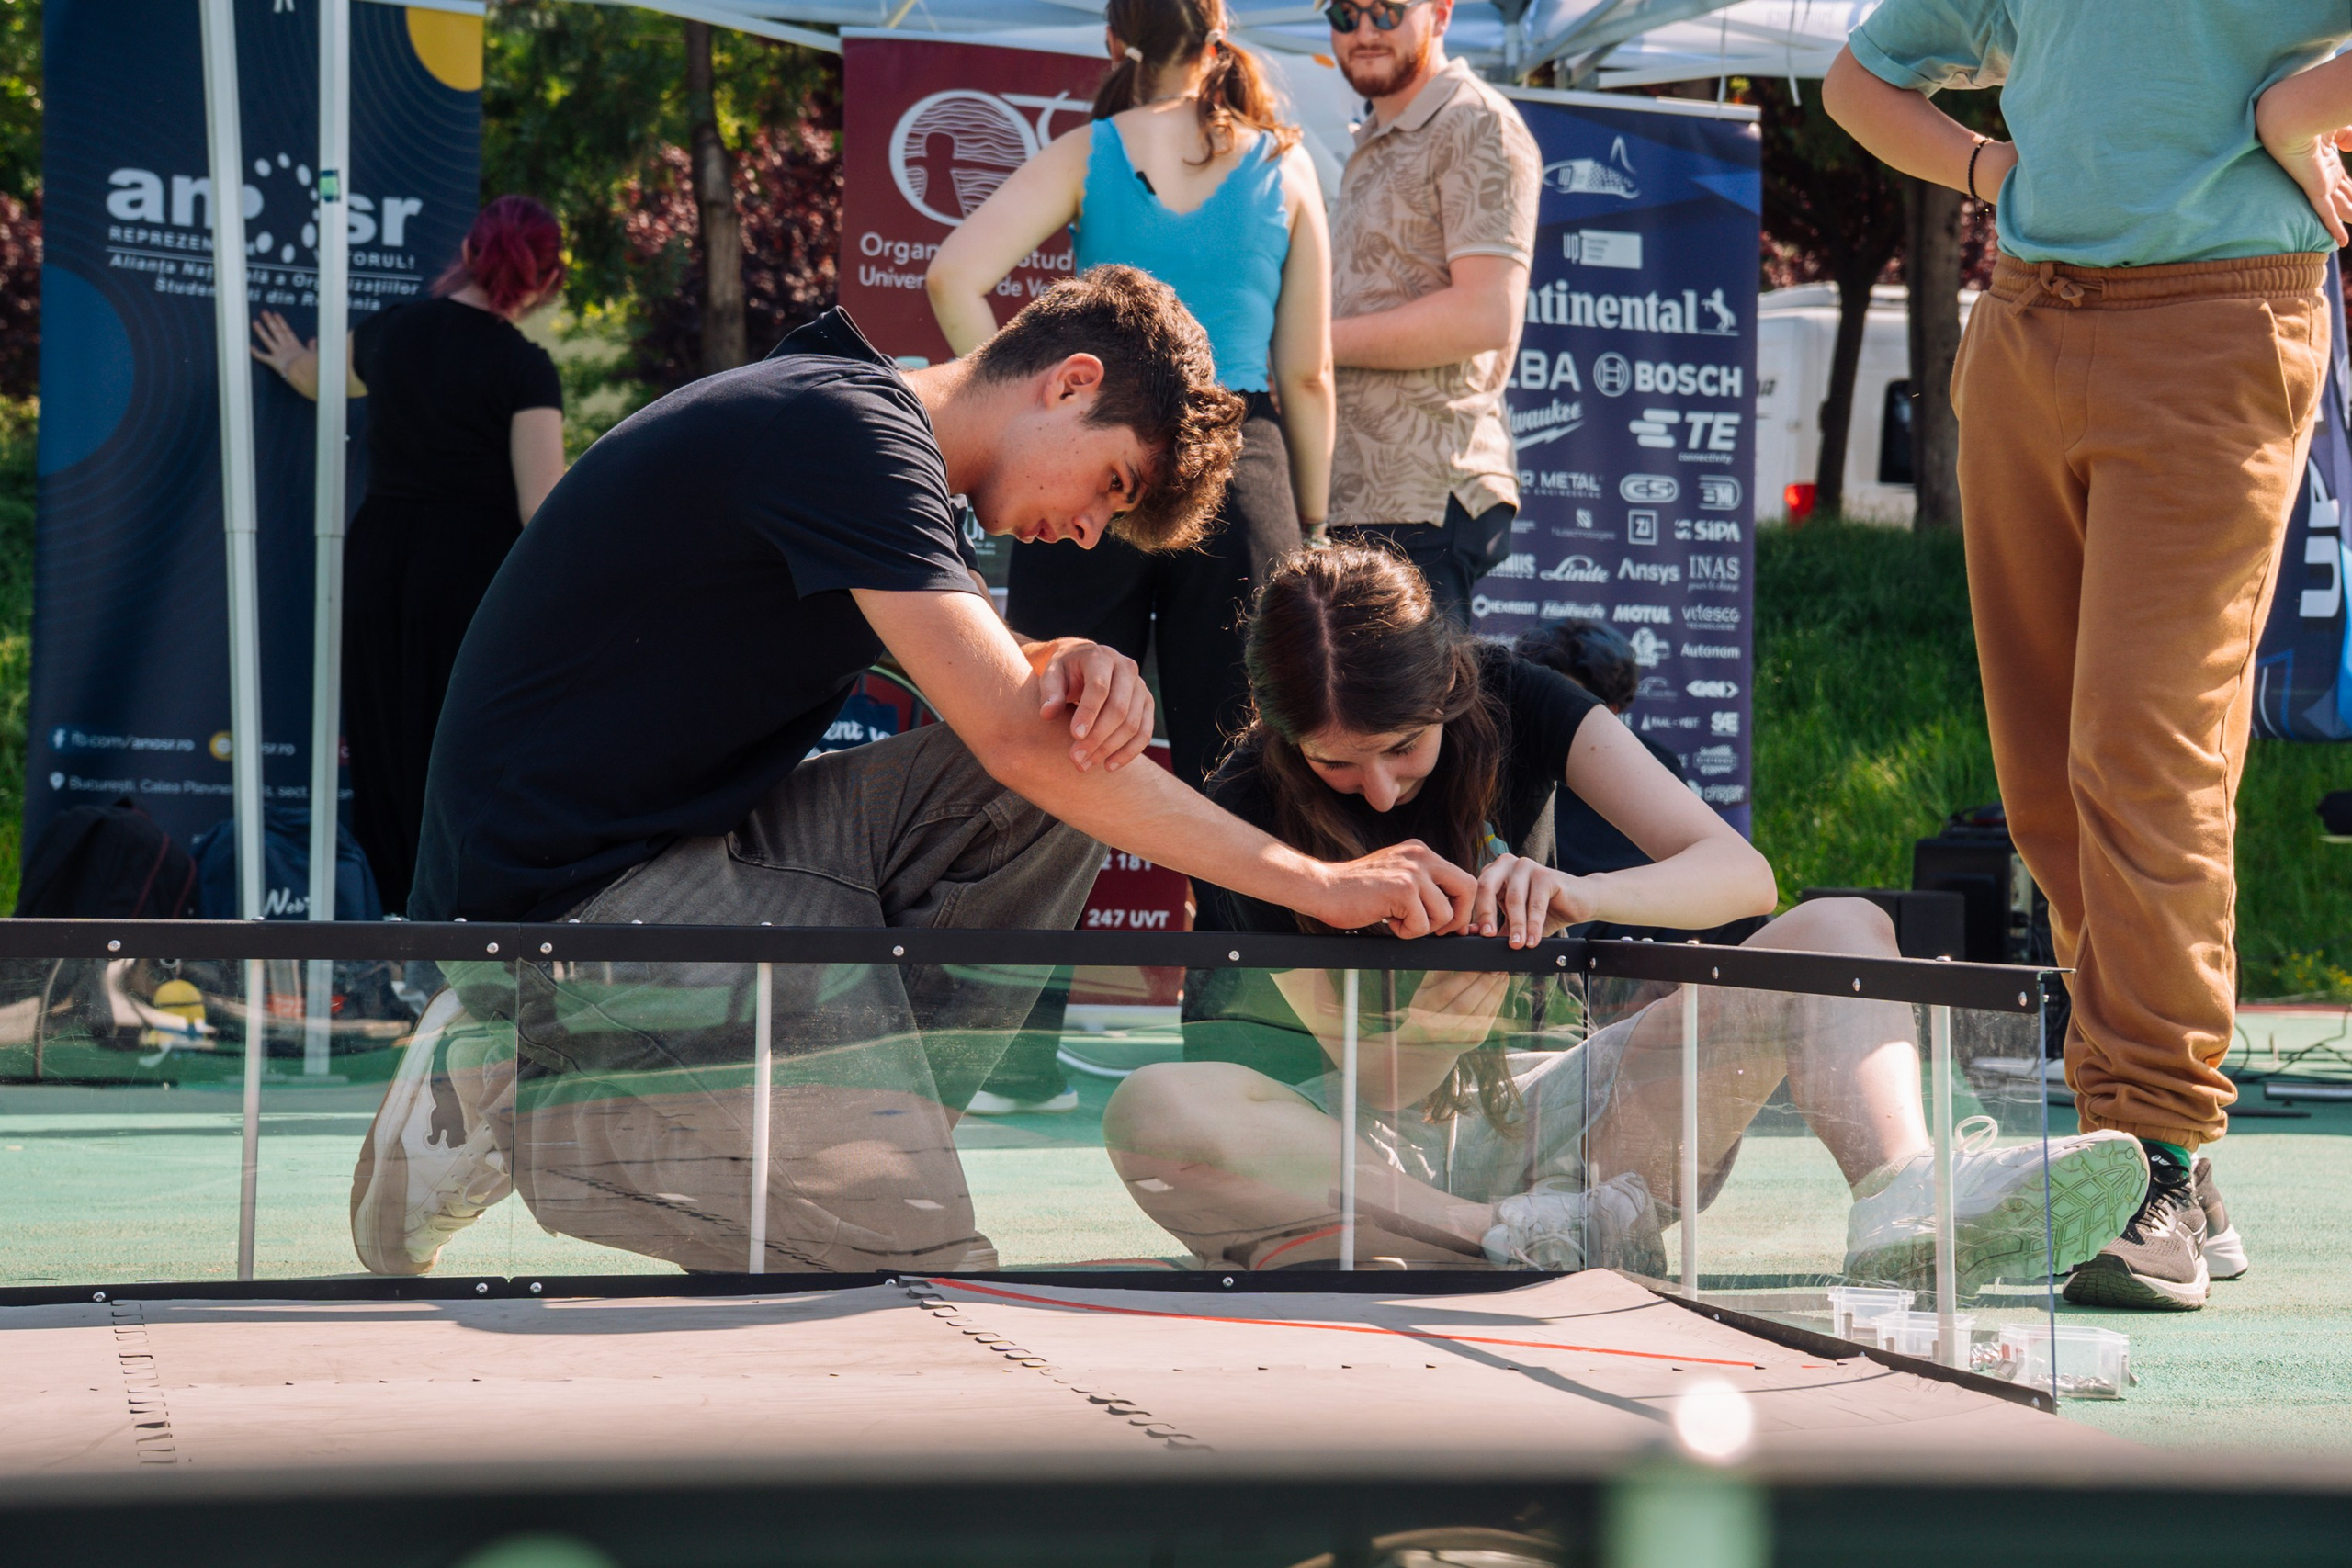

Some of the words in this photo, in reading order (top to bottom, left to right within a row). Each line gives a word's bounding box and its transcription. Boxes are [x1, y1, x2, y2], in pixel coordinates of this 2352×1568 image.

[996, 276, 1023, 297] de
[1634, 360, 1744, 398] BOSCH
[1684, 412, 1741, 451] TE
[1540, 470, 1600, 491] METAL
[1539, 554, 1610, 582] Linde
[1617, 557, 1680, 586] Ansys
[1688, 554, 1741, 581] INAS
[1487, 600, 1537, 615] HEXAGON
[1612, 604, 1672, 624] MOTUL
[1680, 642, 1742, 660] Autonom
[1087, 908, 1126, 928] 247
[1129, 909, 1170, 930] UVT
